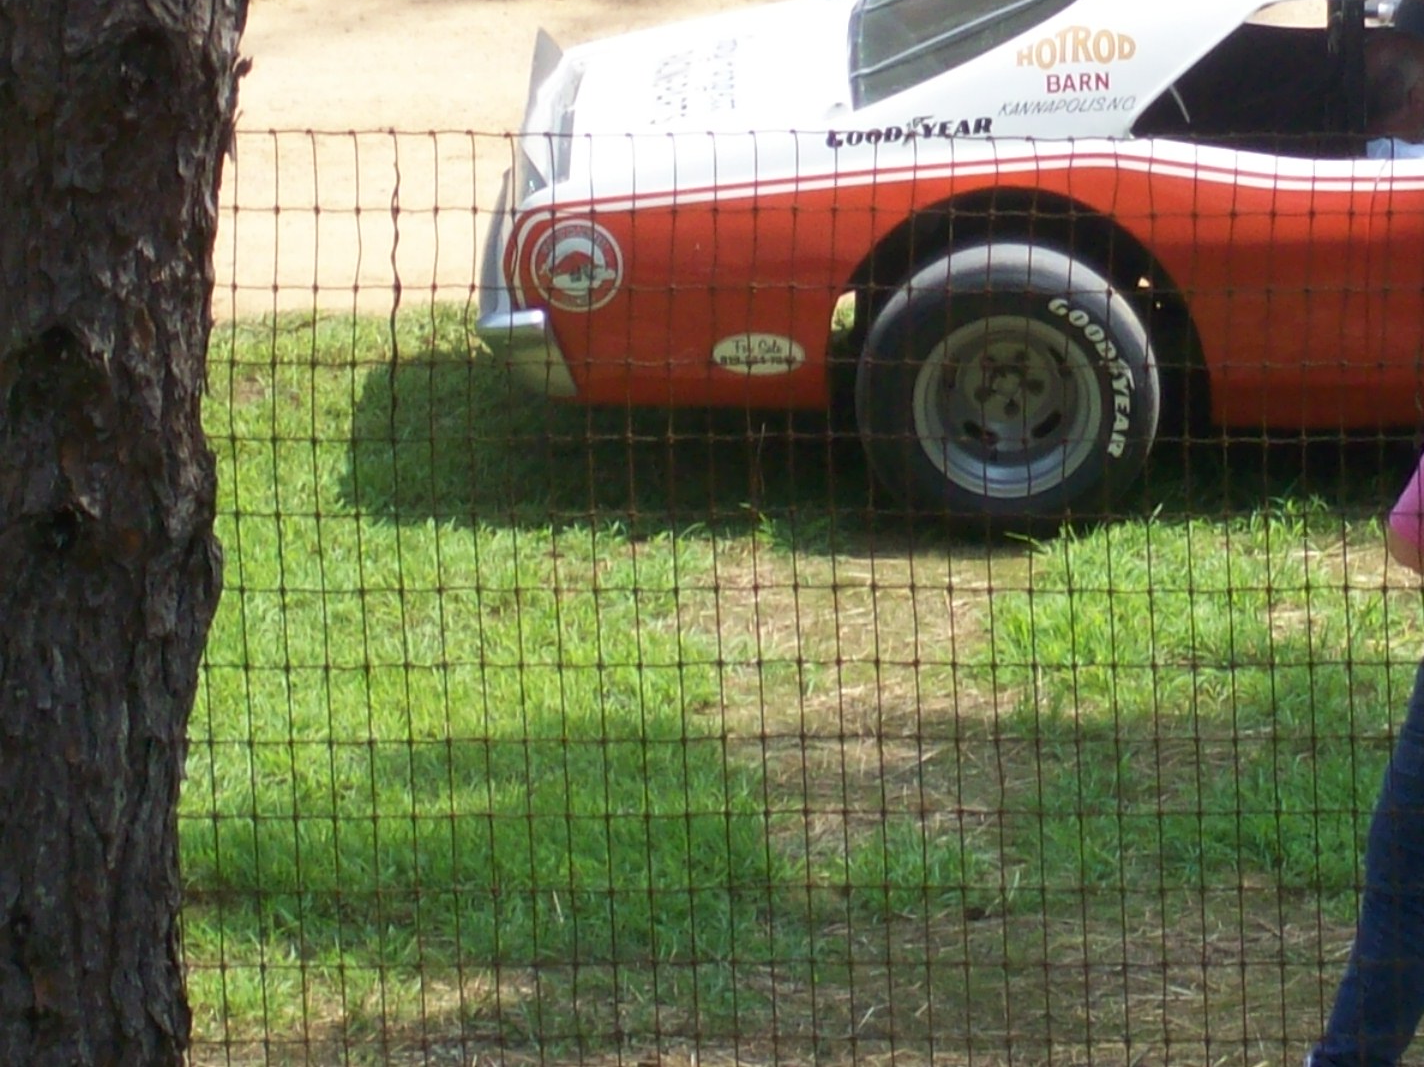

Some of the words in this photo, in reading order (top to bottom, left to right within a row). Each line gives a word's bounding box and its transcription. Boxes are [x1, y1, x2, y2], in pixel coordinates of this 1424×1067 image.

[1046, 72, 1109, 94] BARN
[826, 117, 992, 148] GOODYEAR
[1048, 298, 1136, 459] GOODYEAR
